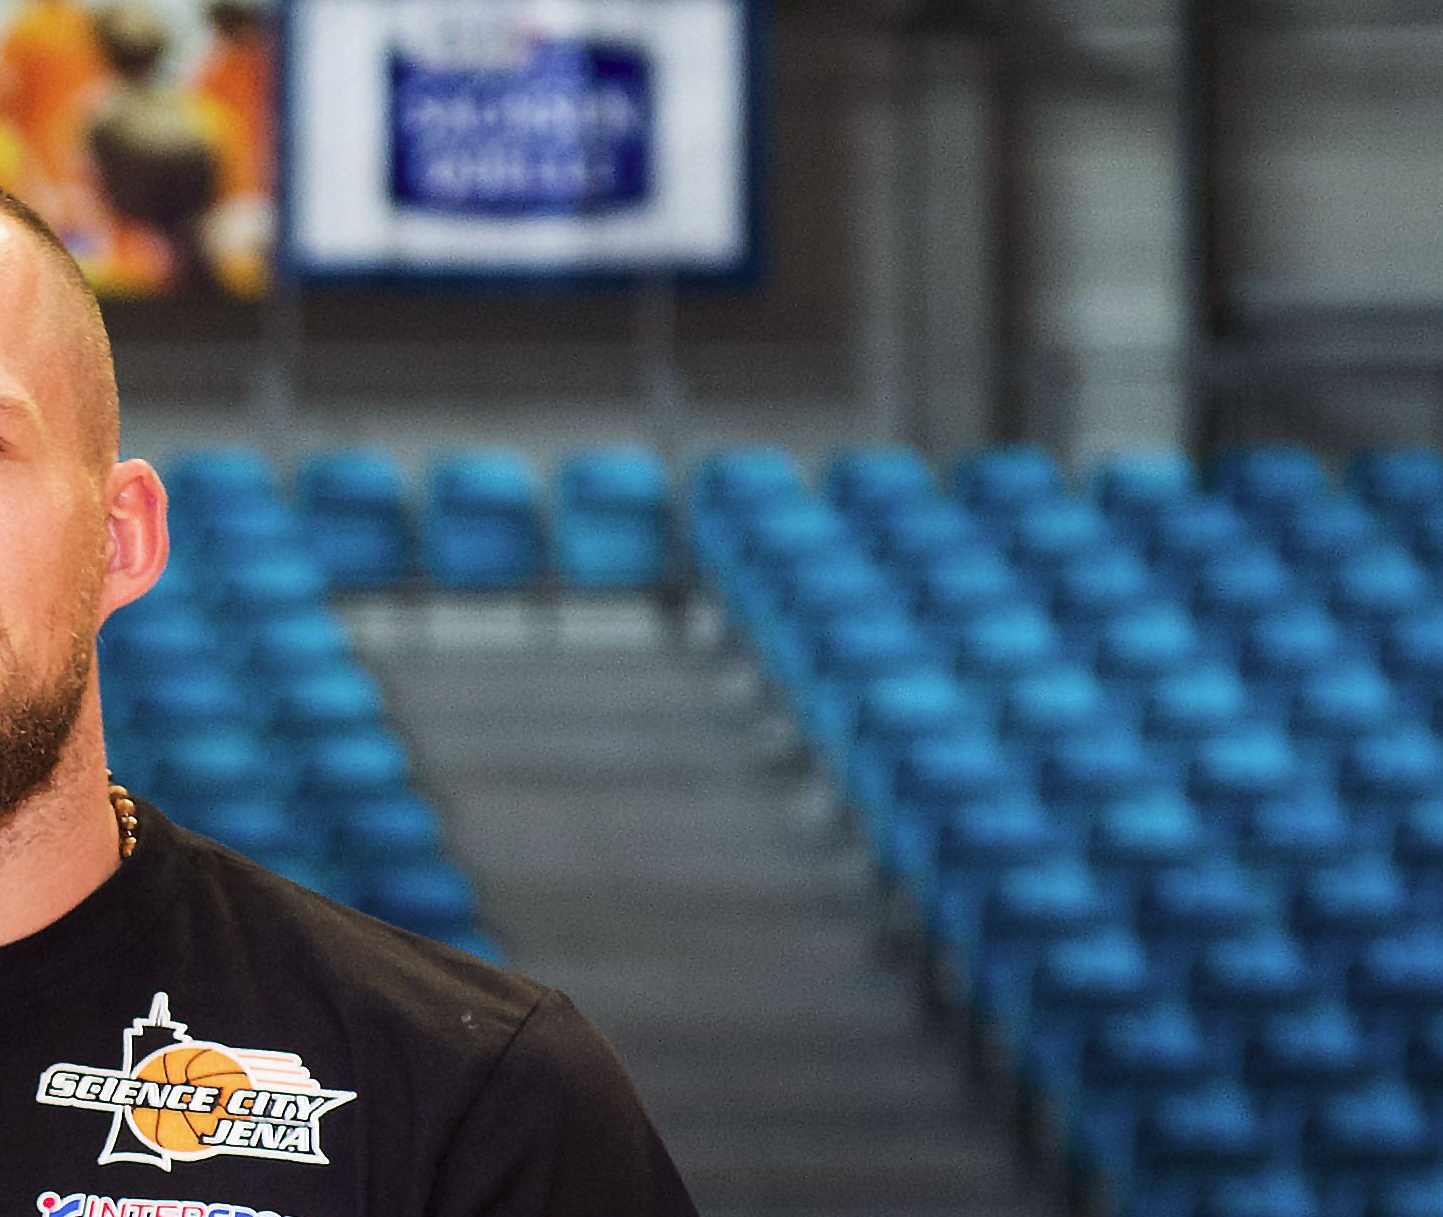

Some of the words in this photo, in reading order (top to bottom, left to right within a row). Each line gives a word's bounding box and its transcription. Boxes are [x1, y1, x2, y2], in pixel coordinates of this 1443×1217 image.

[48, 1070, 219, 1113] SCIENCE
[225, 1089, 326, 1122] CITY
[202, 1117, 312, 1153] JENA
